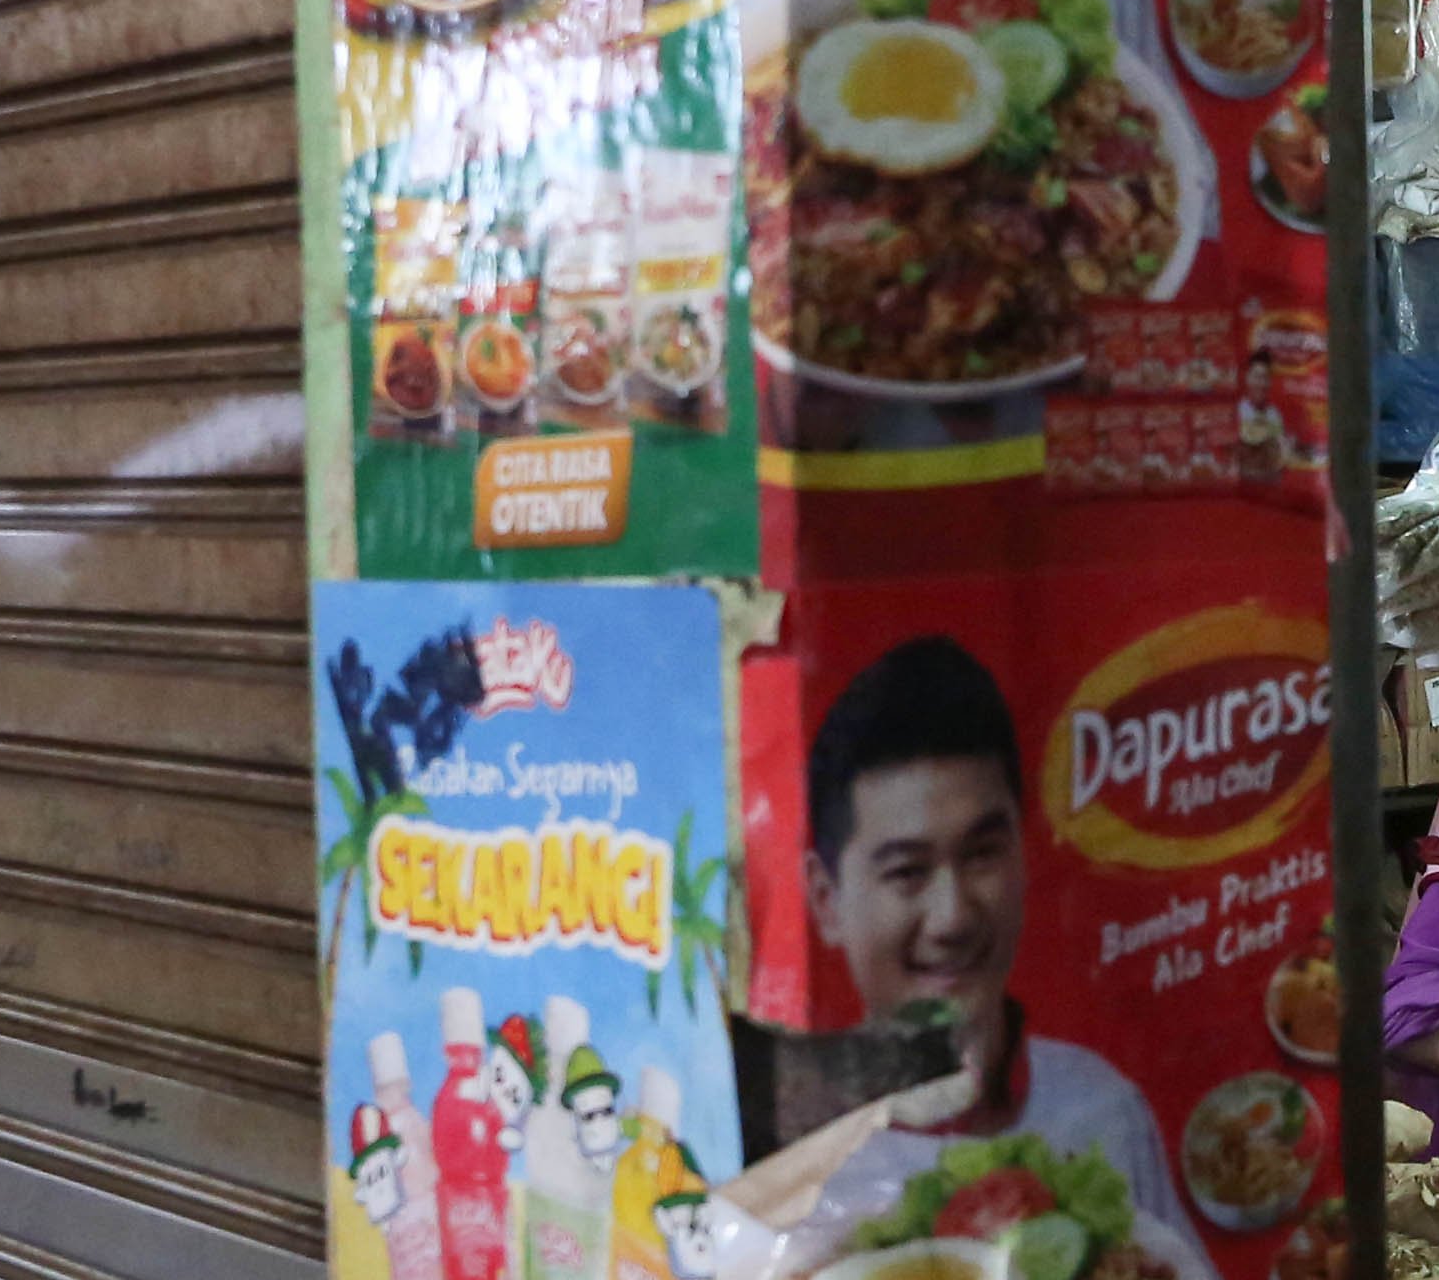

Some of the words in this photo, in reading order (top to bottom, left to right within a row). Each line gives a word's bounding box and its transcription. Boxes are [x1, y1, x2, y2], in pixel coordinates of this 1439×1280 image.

[490, 488, 610, 535] OTENTIK
[1099, 894, 1210, 966] Bumbu
[1218, 846, 1328, 917] Praktis
[1150, 944, 1206, 994] Ala
[1213, 899, 1291, 968] Chef
